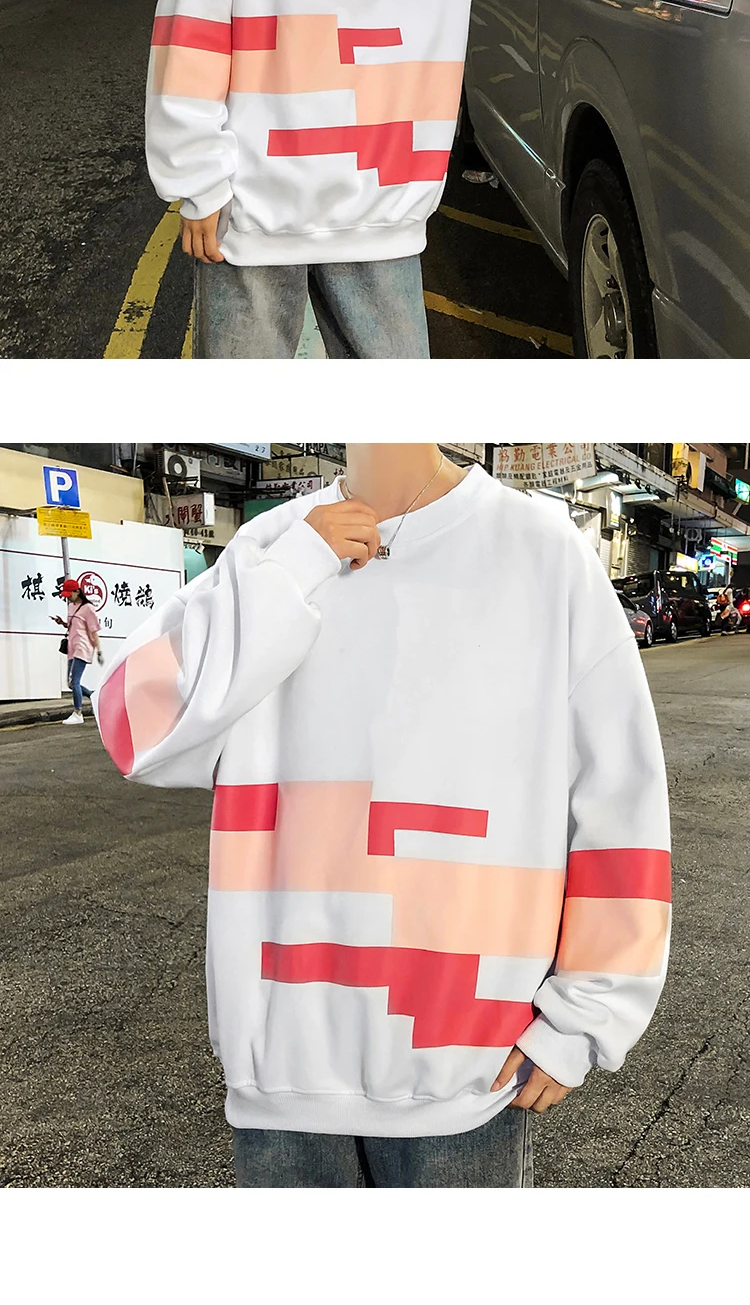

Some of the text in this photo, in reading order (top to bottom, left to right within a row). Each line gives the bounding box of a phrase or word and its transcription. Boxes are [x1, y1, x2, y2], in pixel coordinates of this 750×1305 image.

[510, 461, 536, 471] KUANG
[49, 470, 72, 502] P
[84, 584, 99, 595] Ki's
[111, 581, 155, 609] 燒鵝
